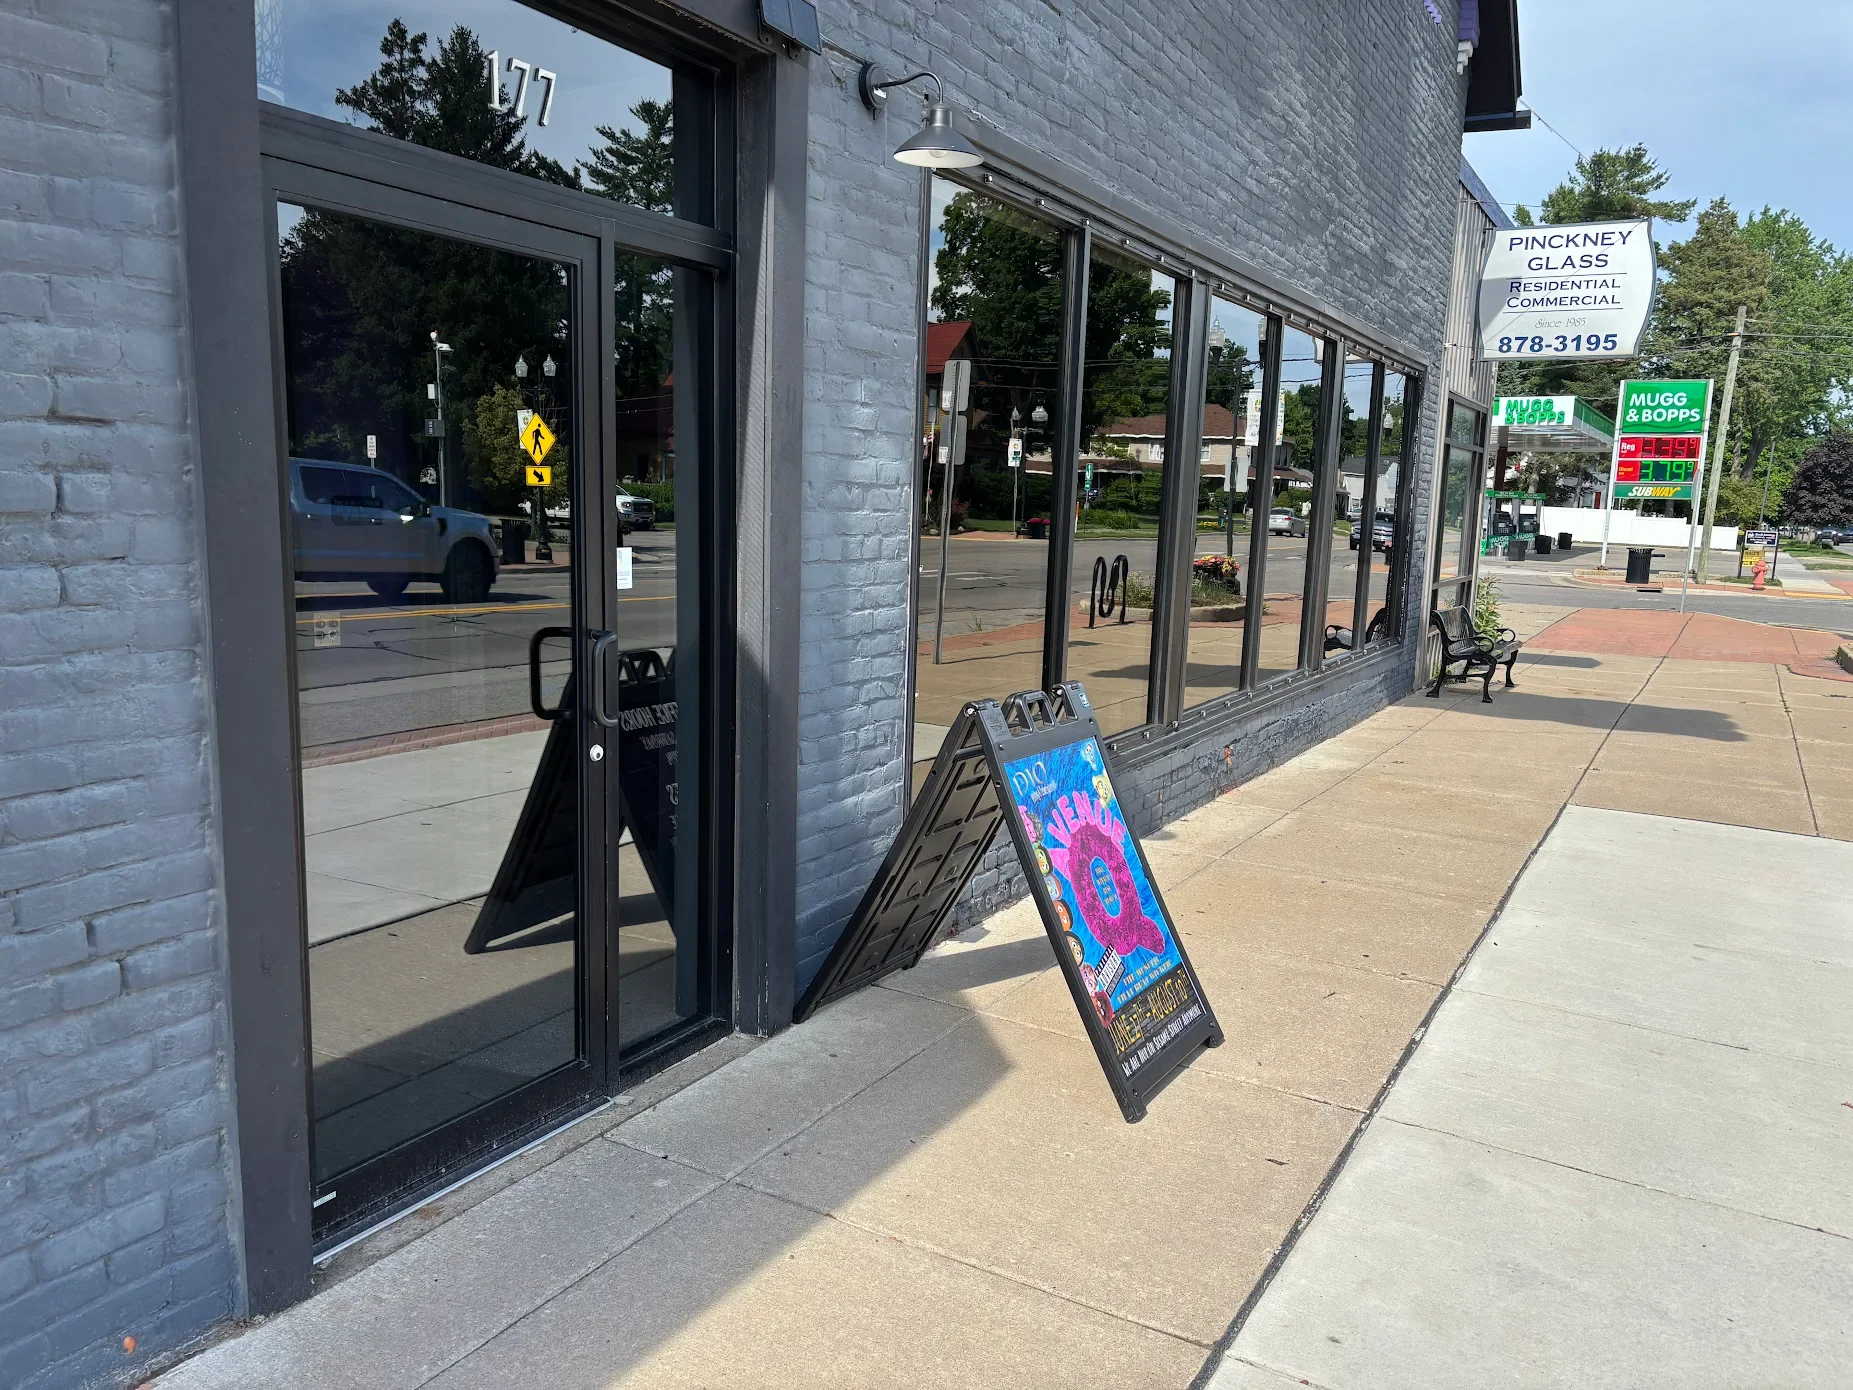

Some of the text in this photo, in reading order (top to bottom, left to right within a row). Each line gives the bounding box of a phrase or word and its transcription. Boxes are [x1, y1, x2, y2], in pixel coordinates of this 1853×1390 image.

[485, 50, 557, 127] 177
[1508, 230, 1633, 252] PINCKNEY
[1527, 253, 1609, 271] GLASS
[1509, 278, 1621, 293] RESIDENTIAL
[1506, 294, 1621, 308] COMMERCIAL
[1534, 317, 1587, 329] Since 1985
[1498, 333, 1618, 353] 878-3195
[1506, 398, 1554, 412] MUGG
[1629, 392, 1688, 407] MUGG
[1641, 408, 1700, 422] BOPPS
[1621, 442, 1636, 452] Reg
[1627, 486, 1682, 497] SUBWAY
[1013, 761, 1047, 796] DIO
[1049, 790, 1127, 882] AVENUE
[1068, 820, 1166, 957] Q
[1099, 951, 1121, 991] ADVISORY
[1107, 1014, 1136, 1056] JUNE
[1147, 978, 1180, 1022] AUGUST
